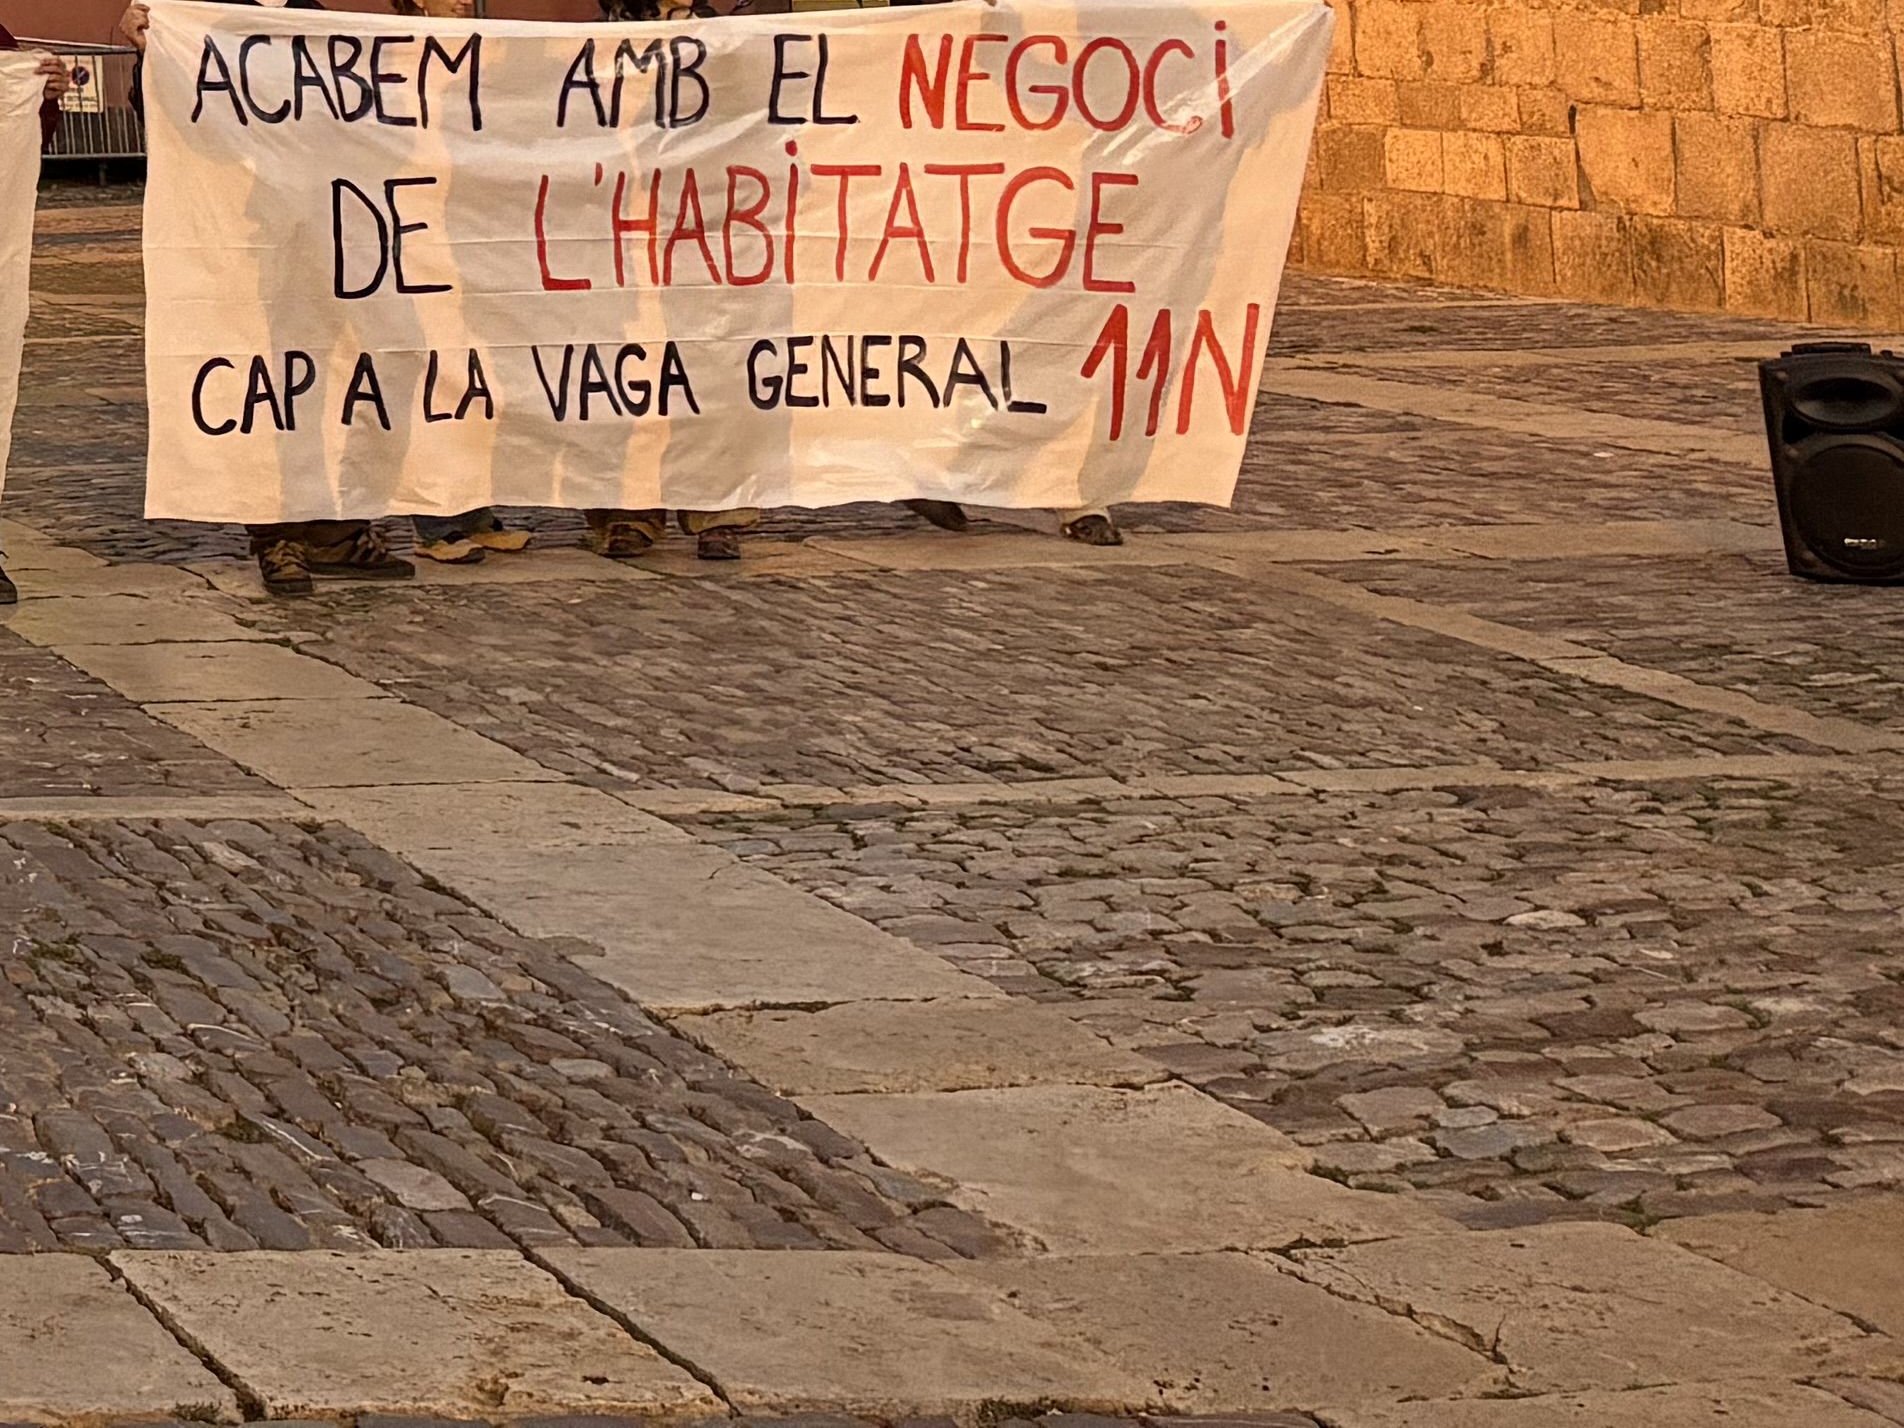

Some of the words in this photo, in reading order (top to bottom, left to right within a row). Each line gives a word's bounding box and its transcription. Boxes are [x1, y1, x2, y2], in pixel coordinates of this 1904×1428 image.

[191, 33, 482, 131] ACABEM
[557, 36, 709, 128] AMB
[768, 34, 858, 124] EL
[332, 177, 452, 299] DE
[536, 142, 1138, 293] L'HABITATGE
[192, 351, 315, 435] CAP
[342, 352, 391, 430] A
[424, 349, 493, 422] LA
[531, 341, 700, 421] VAGA
[747, 335, 1047, 414] GENERAL
[1082, 304, 1259, 440] 11N
